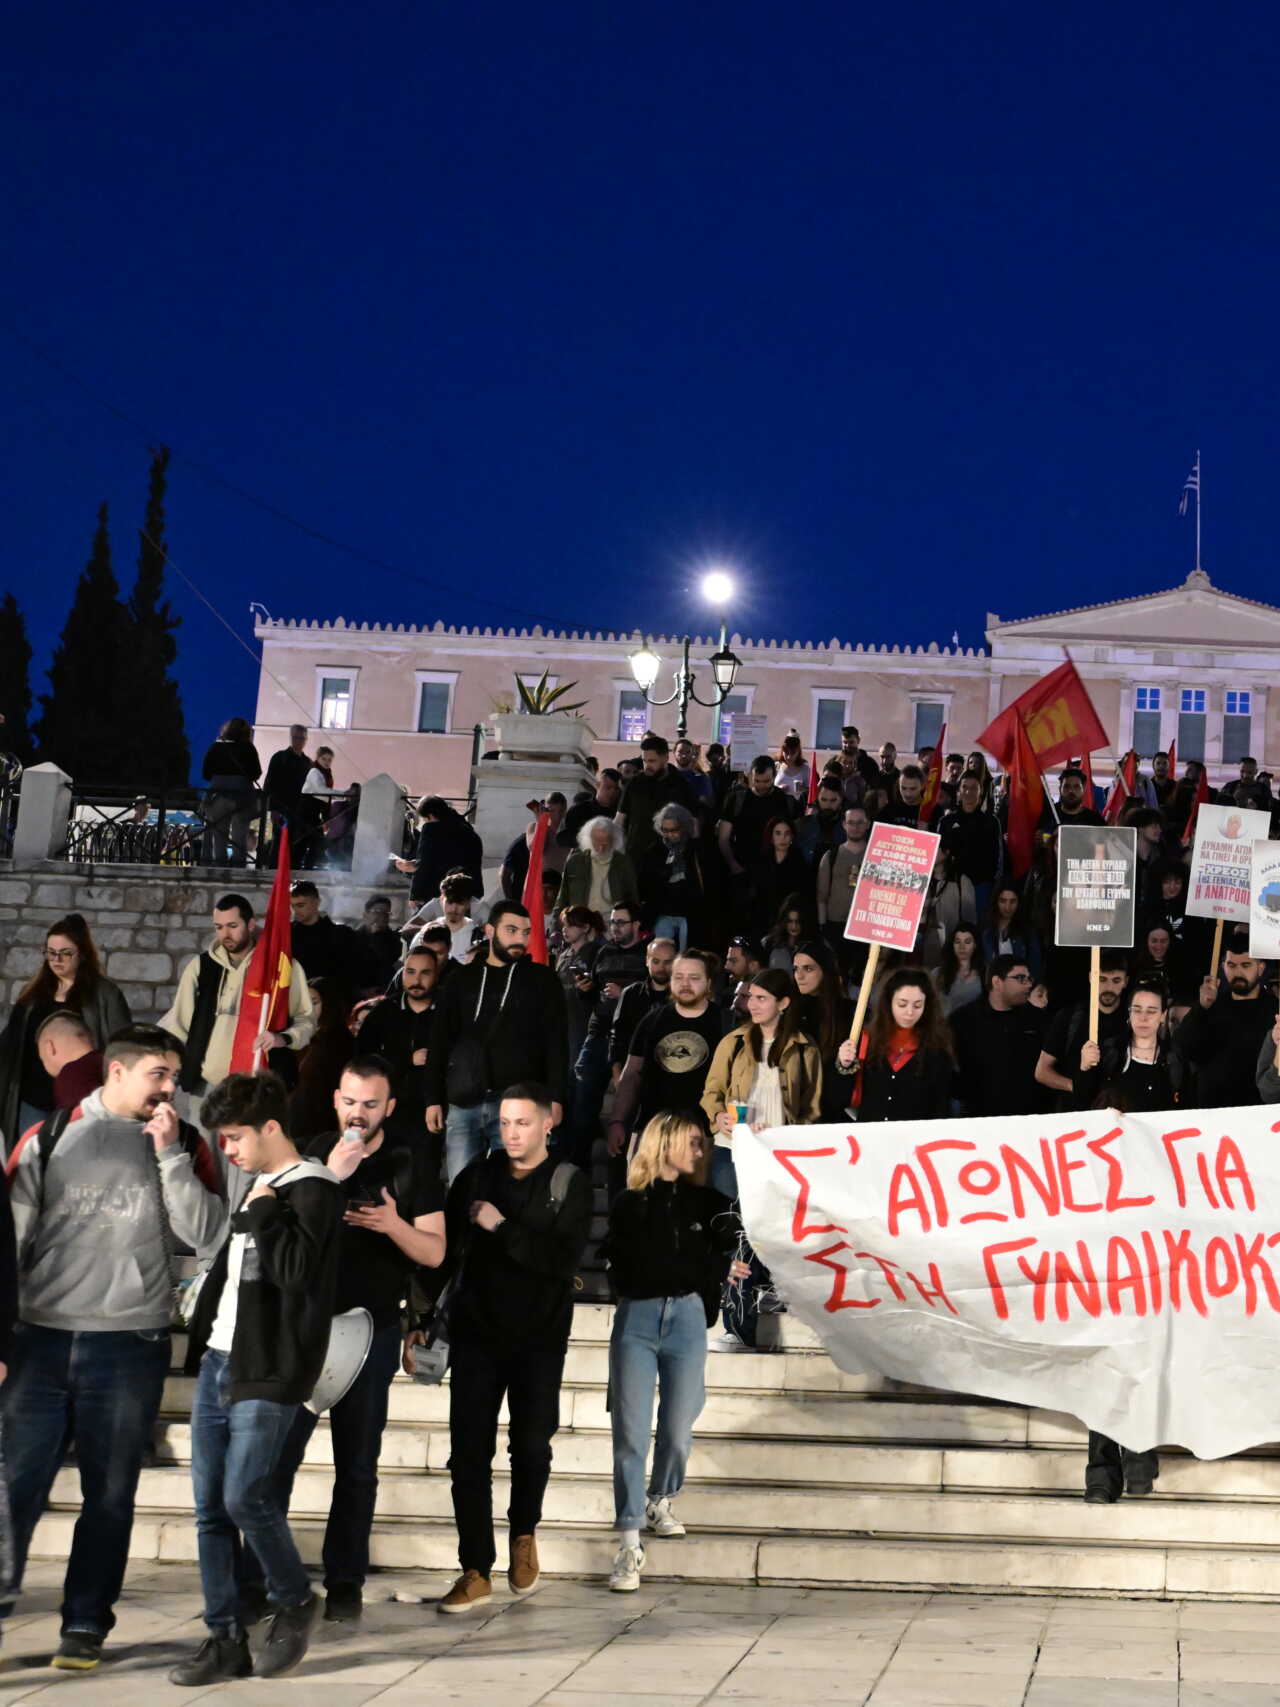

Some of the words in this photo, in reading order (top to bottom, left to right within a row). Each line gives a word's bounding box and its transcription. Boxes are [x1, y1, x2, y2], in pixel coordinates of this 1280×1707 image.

[1194, 884, 1201, 900] Η
[887, 1128, 1156, 1238] ΑΓΩΝΕΣ
[1161, 1127, 1257, 1212] ΓΙΑ
[803, 1241, 960, 1315] ΣΤΗ
